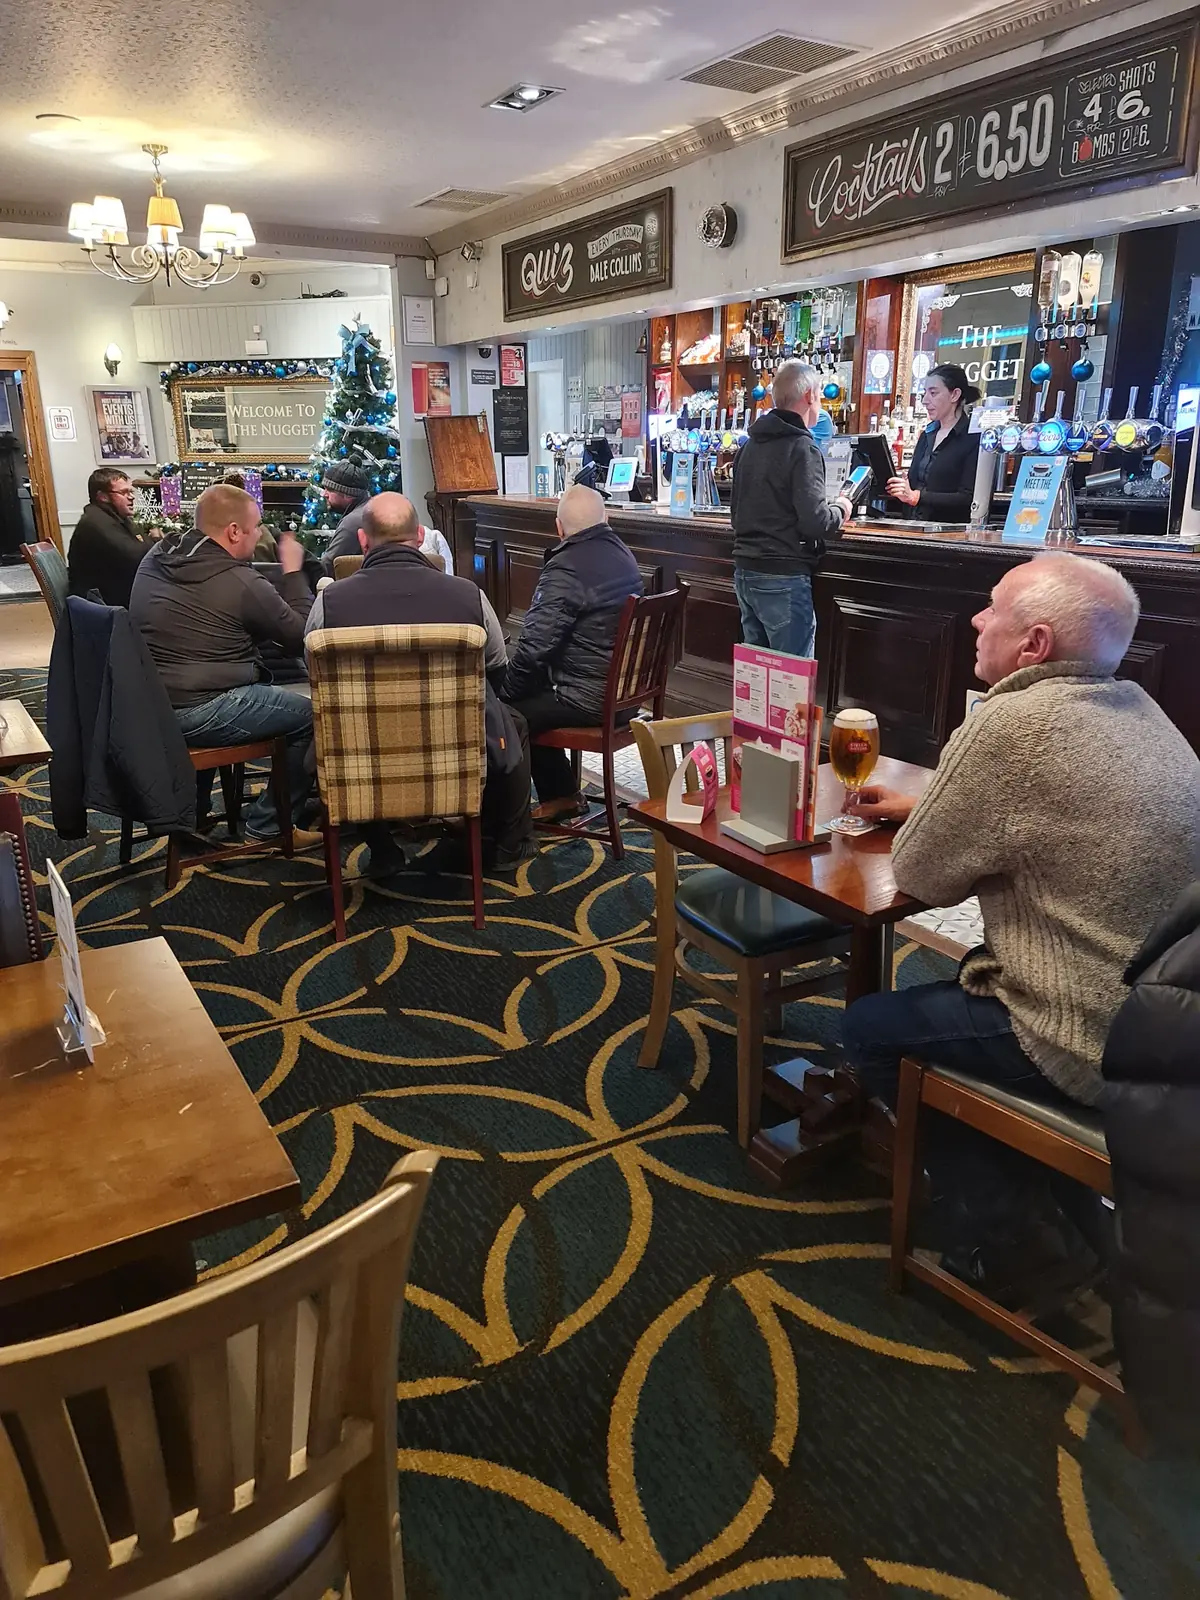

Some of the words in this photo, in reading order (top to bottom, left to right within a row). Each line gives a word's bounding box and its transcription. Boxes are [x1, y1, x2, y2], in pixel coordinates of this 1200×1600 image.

[1119, 60, 1156, 92] SHOTS
[1083, 93, 1103, 123] 4
[808, 126, 928, 228] Cocktails
[933, 121, 954, 184] 2
[591, 234, 610, 255] EVERY
[612, 226, 642, 241] THURSDAY
[590, 260, 609, 283] DALE
[609, 252, 642, 277] COLLINS
[957, 324, 1003, 350] THE
[935, 358, 1025, 383] GGET
[102, 403, 134, 415] EVENTS
[104, 414, 125, 425] WITH
[124, 415, 136, 425] US
[228, 404, 293, 418] WELCOME
[295, 403, 316, 417] TO
[231, 423, 258, 436] THE
[260, 422, 316, 436] NUGGET
[1024, 478, 1040, 489] MEET
[1041, 478, 1053, 490] THE
